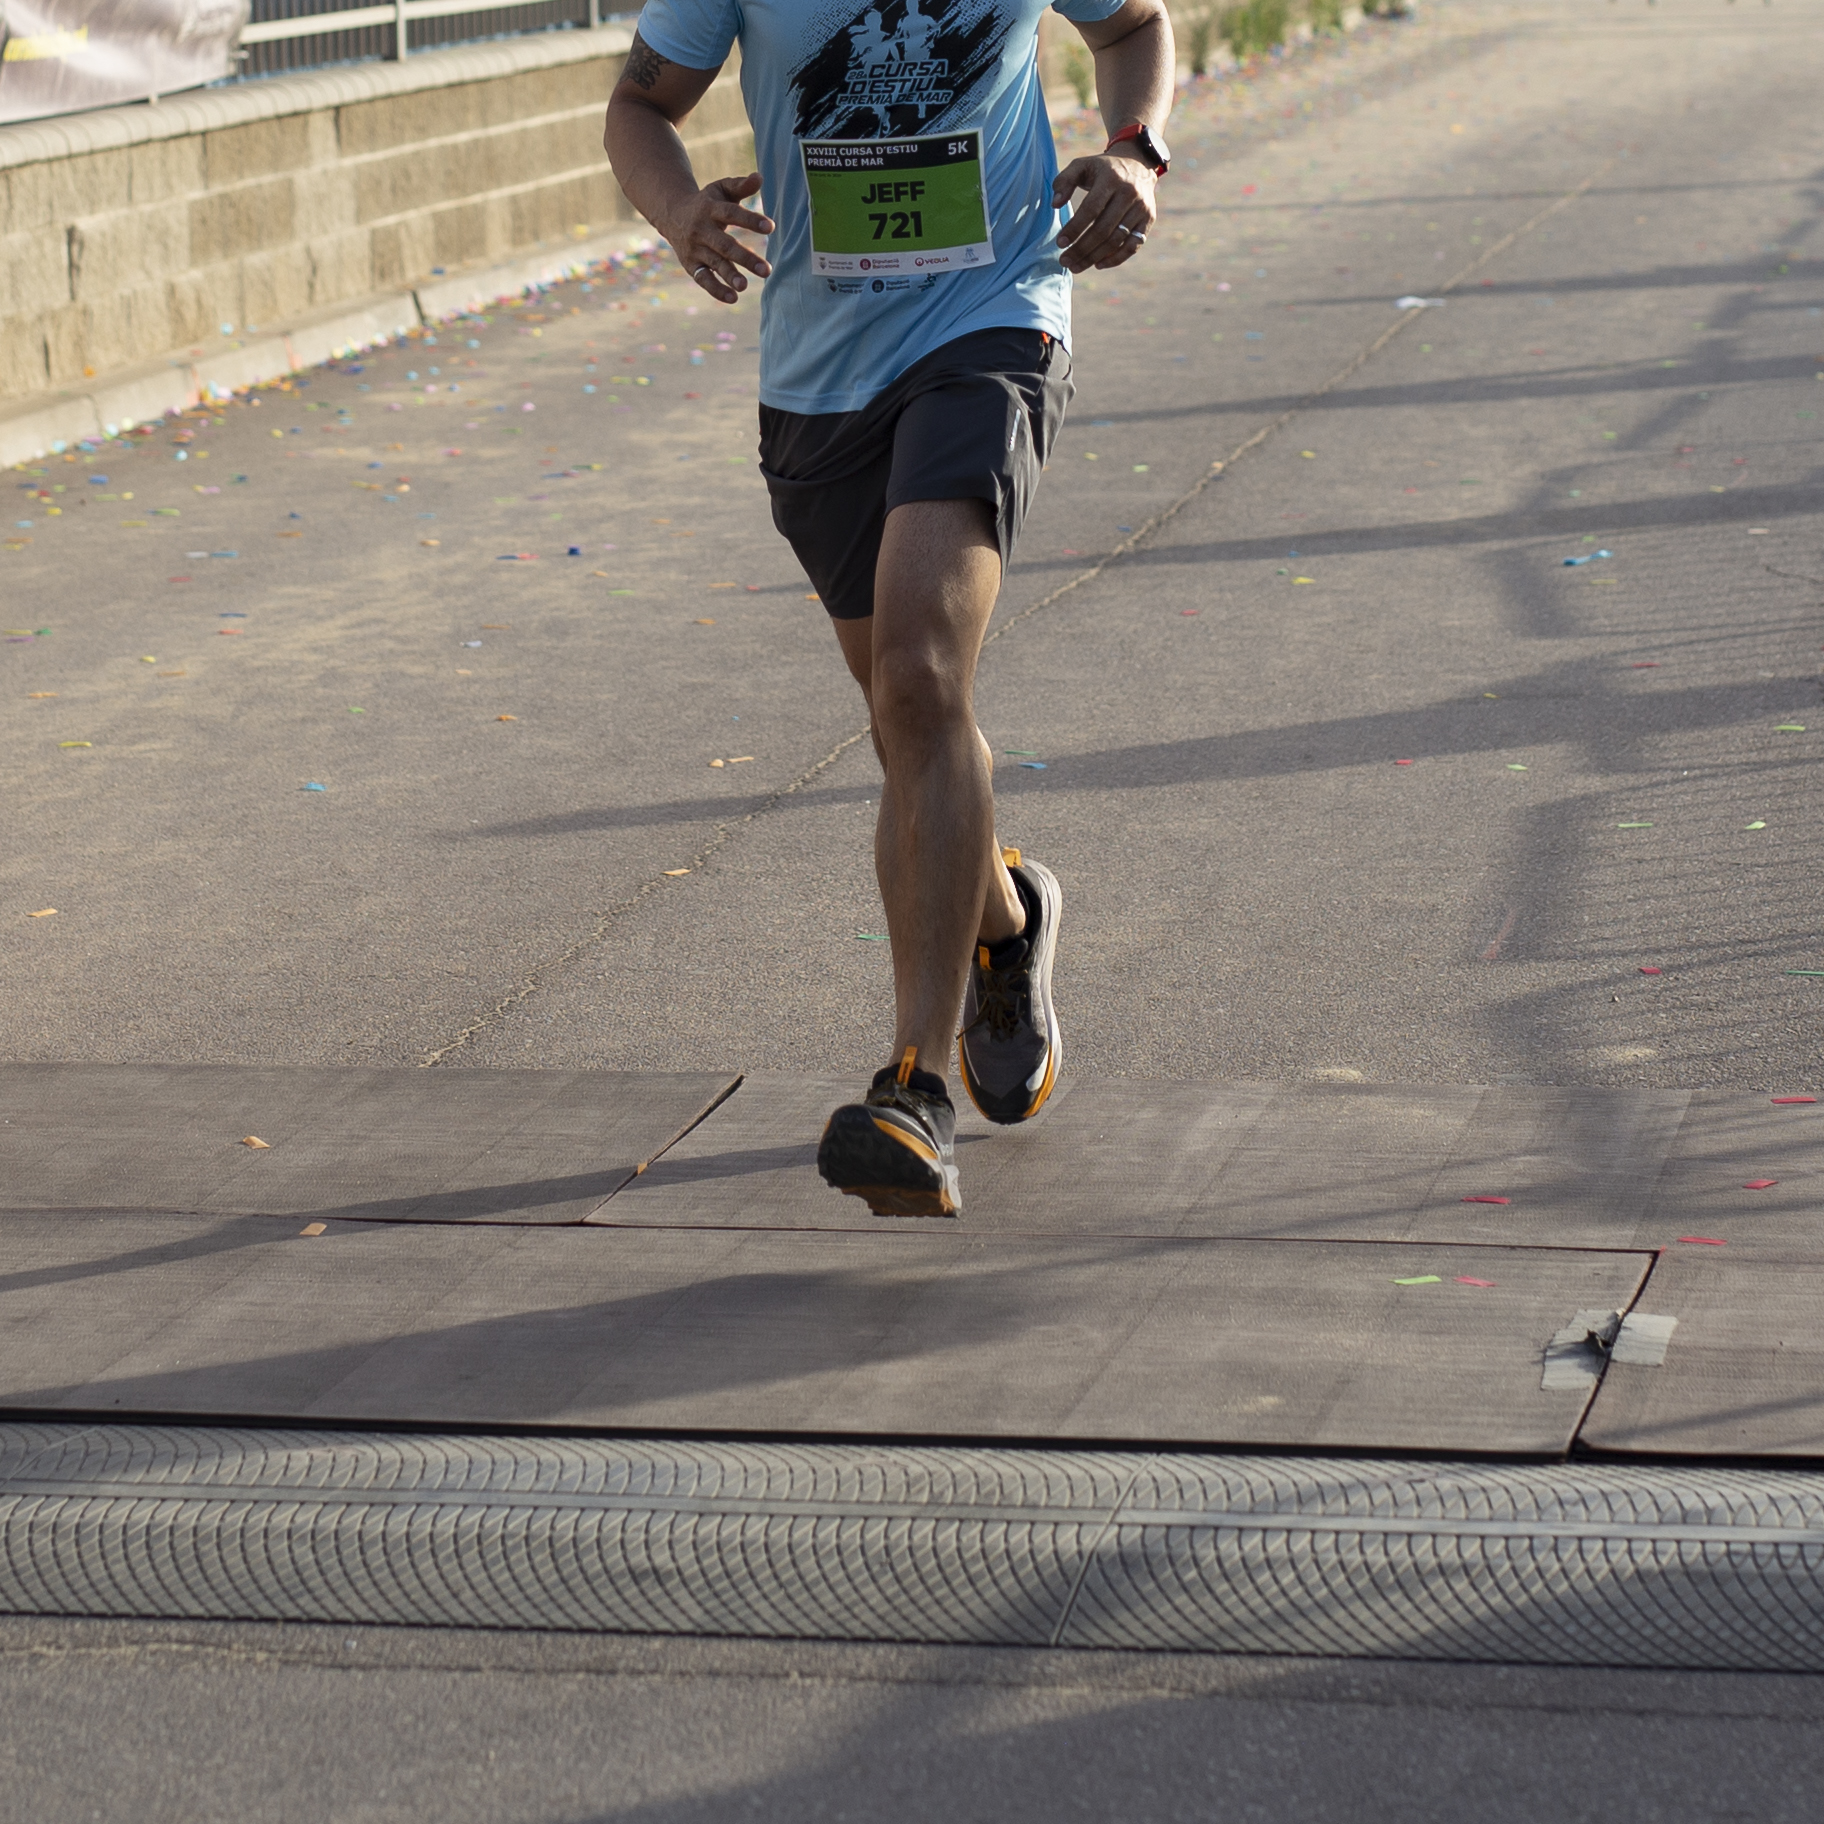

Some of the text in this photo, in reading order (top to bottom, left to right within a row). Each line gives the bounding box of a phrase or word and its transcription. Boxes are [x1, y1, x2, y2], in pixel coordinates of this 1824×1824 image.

[869, 61, 946, 78] CURSA
[849, 78, 934, 94] D'ESTIU
[896, 93, 916, 103] DE
[917, 92, 952, 102] MAR
[806, 147, 837, 156] XXVIII
[839, 147, 873, 156] CURSA
[948, 141, 968, 156] 5K
[807, 156, 884, 167] PREMIÀ DE MAR
[861, 181, 925, 204] JEFF
[868, 211, 923, 240] 721
